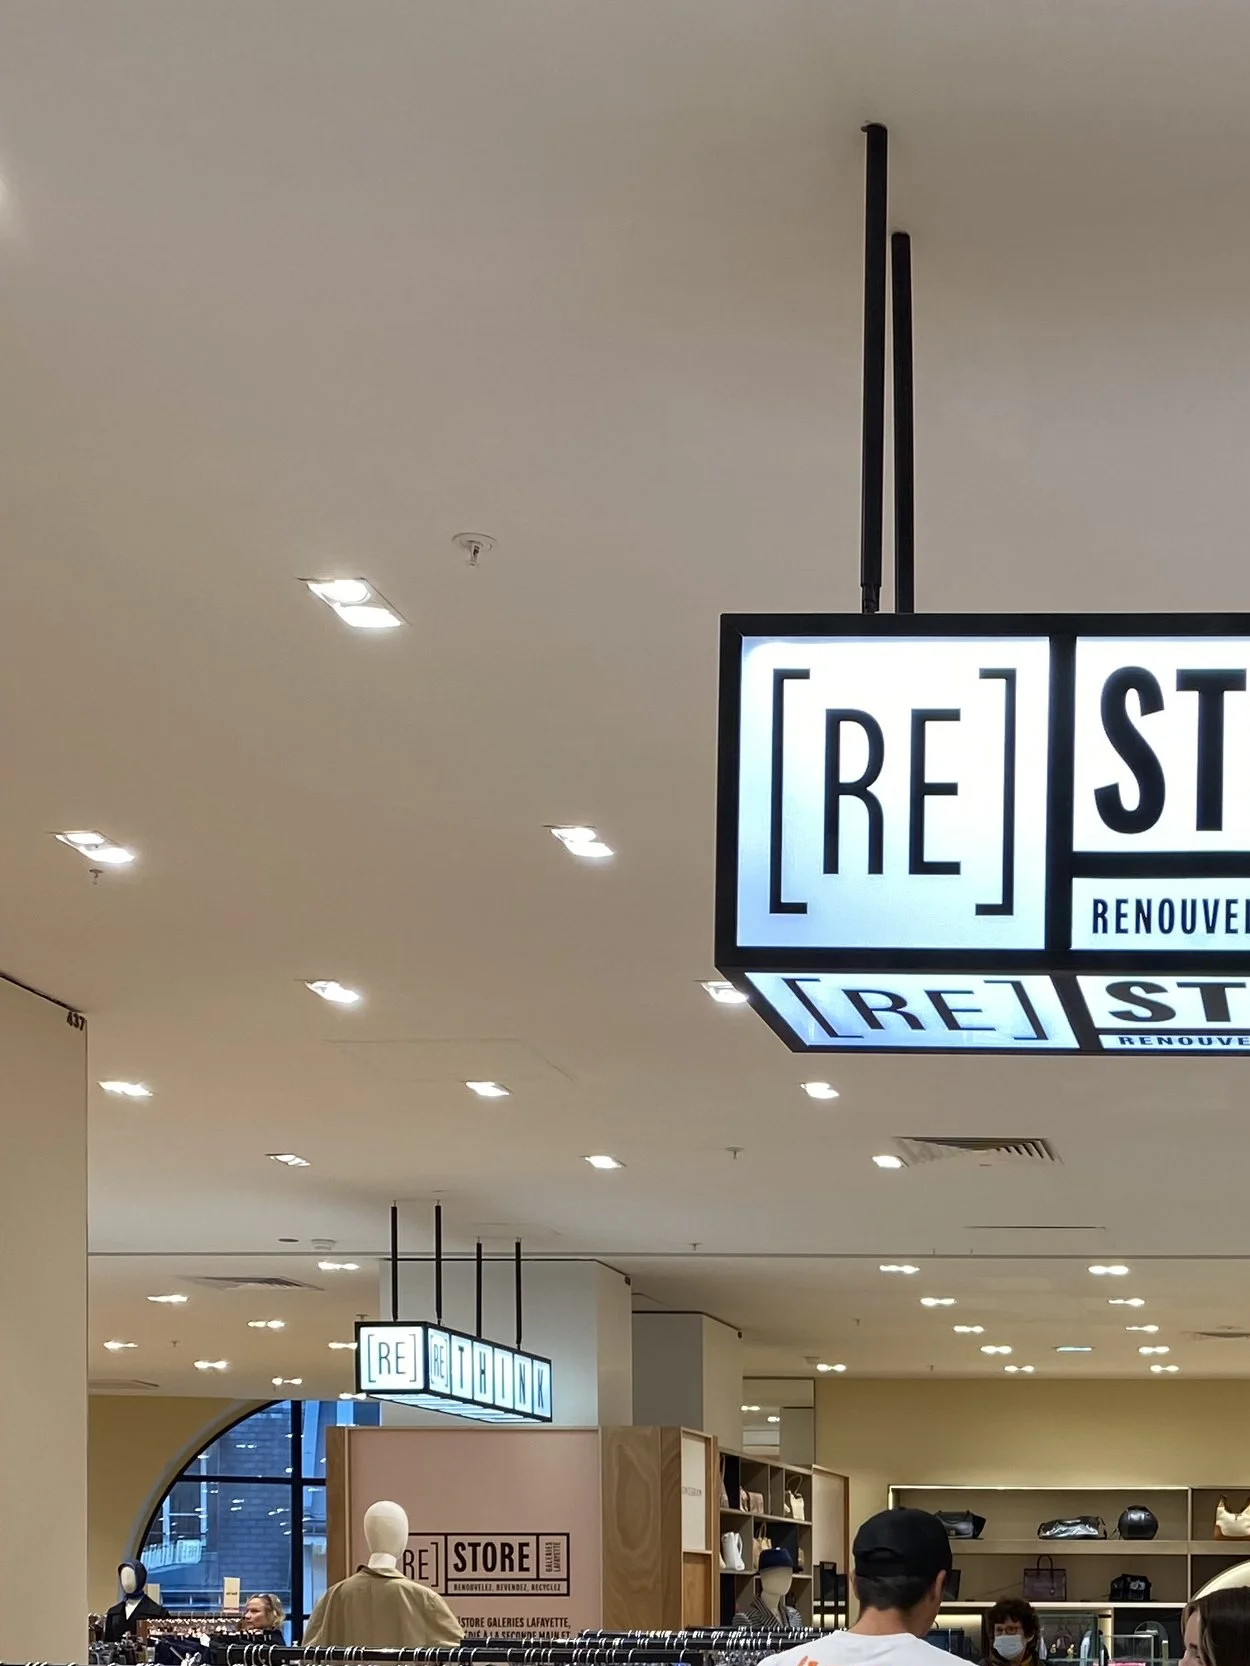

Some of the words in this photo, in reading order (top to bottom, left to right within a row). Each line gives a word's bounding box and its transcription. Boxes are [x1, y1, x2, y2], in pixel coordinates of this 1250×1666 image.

[769, 667, 1017, 916] [RE]
[782, 977, 1048, 1041] [RE]
[367, 1333, 417, 1383] [RE]
[403, 1542, 439, 1587] RE]
[453, 1542, 530, 1572] STORE
[553, 1542, 561, 1573] LAFAYETTE
[454, 1583, 495, 1592] RENOUVELEZ,
[496, 1583, 529, 1592] REVENDEZ,
[531, 1583, 561, 1592] RECYCLEZ
[487, 1617, 525, 1628] GALERIES
[527, 1617, 571, 1629] LAFAYETTE,
